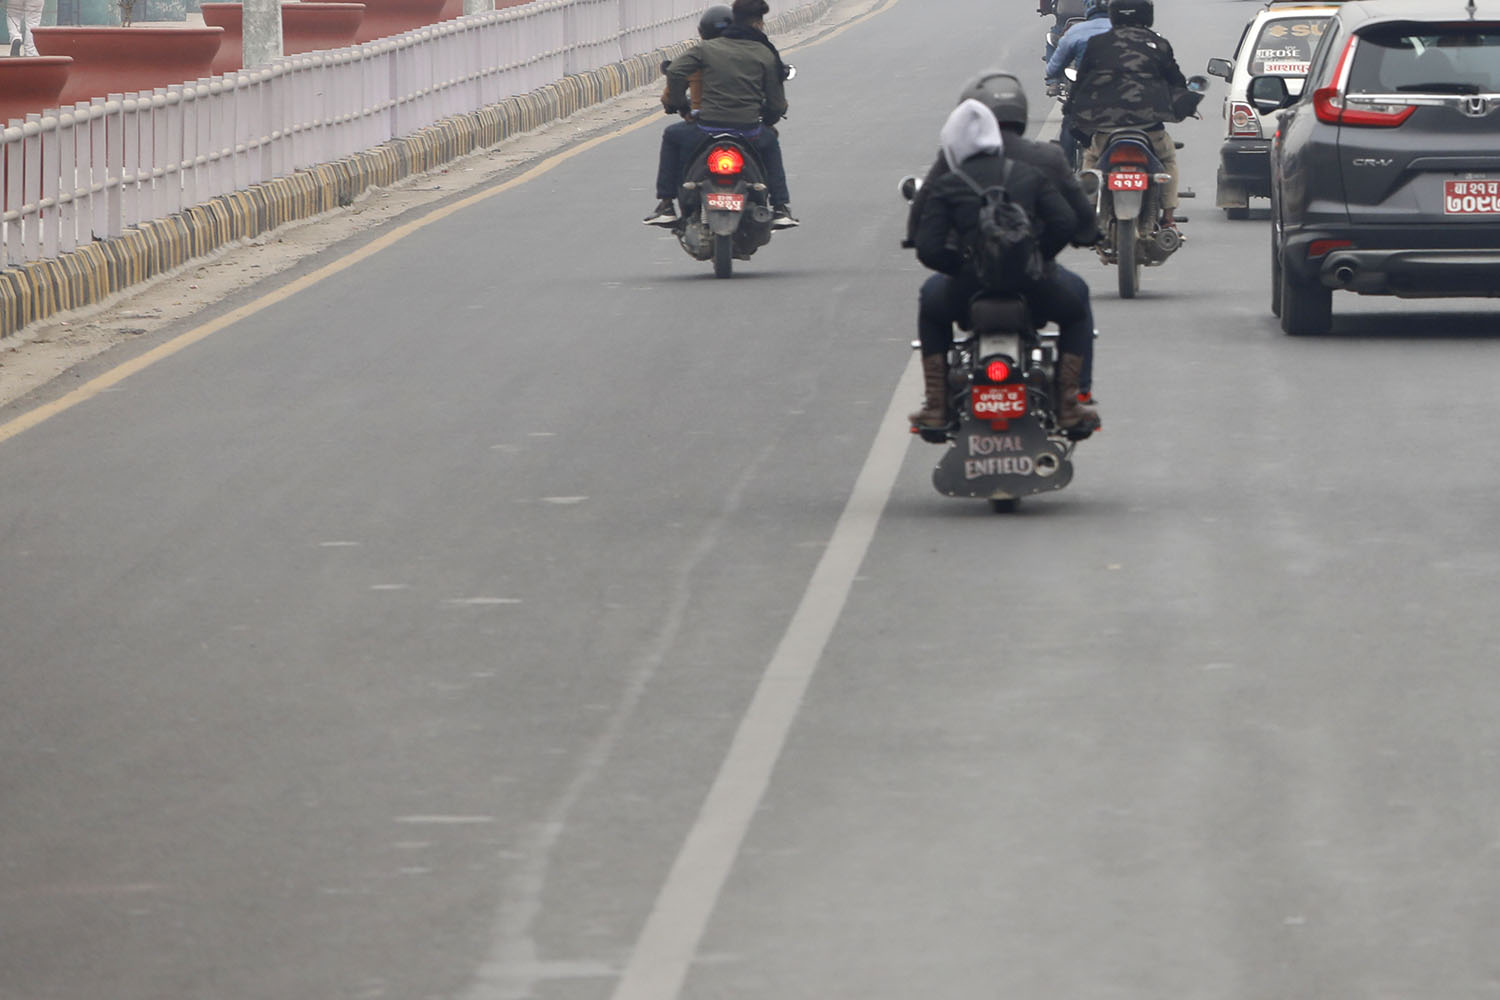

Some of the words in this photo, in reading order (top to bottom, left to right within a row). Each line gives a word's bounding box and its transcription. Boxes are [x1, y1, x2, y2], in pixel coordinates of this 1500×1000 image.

[1351, 158, 1394, 168] CR-V
[967, 434, 1024, 457] ROYAL
[964, 455, 1034, 480] ENFIELD
